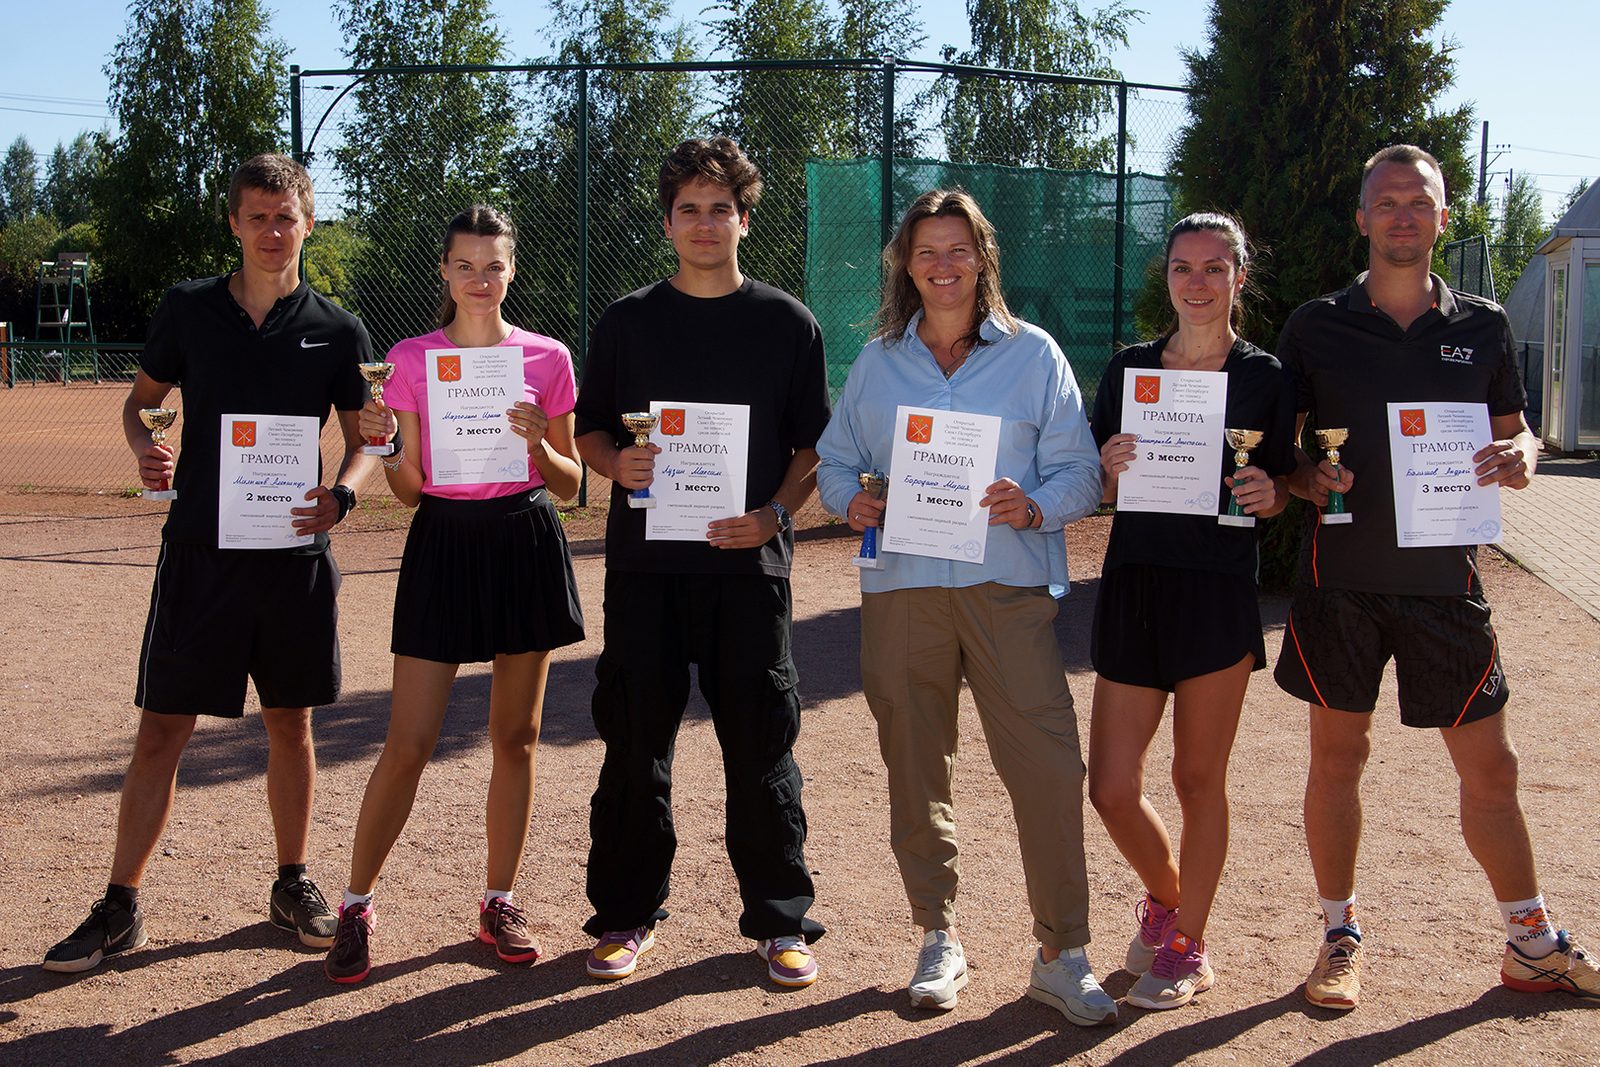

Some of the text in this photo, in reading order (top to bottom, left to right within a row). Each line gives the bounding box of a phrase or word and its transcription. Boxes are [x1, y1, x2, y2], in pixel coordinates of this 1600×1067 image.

[1440, 344, 1474, 360] EA7
[447, 386, 506, 398] ГРАМОТА
[1143, 410, 1204, 423] ГРАМОТА
[455, 427, 502, 436] 2 место
[669, 442, 728, 454] ГРАМОТА
[1412, 441, 1475, 453] ГРАМОТА
[241, 453, 300, 465] ГРАМОТА
[912, 450, 975, 467] ГРАМОТА
[1147, 452, 1195, 463] 3 место
[675, 482, 721, 492] 1 место
[1422, 484, 1471, 494] 3 место
[246, 492, 292, 502] 2 место
[916, 493, 963, 507] 1 место
